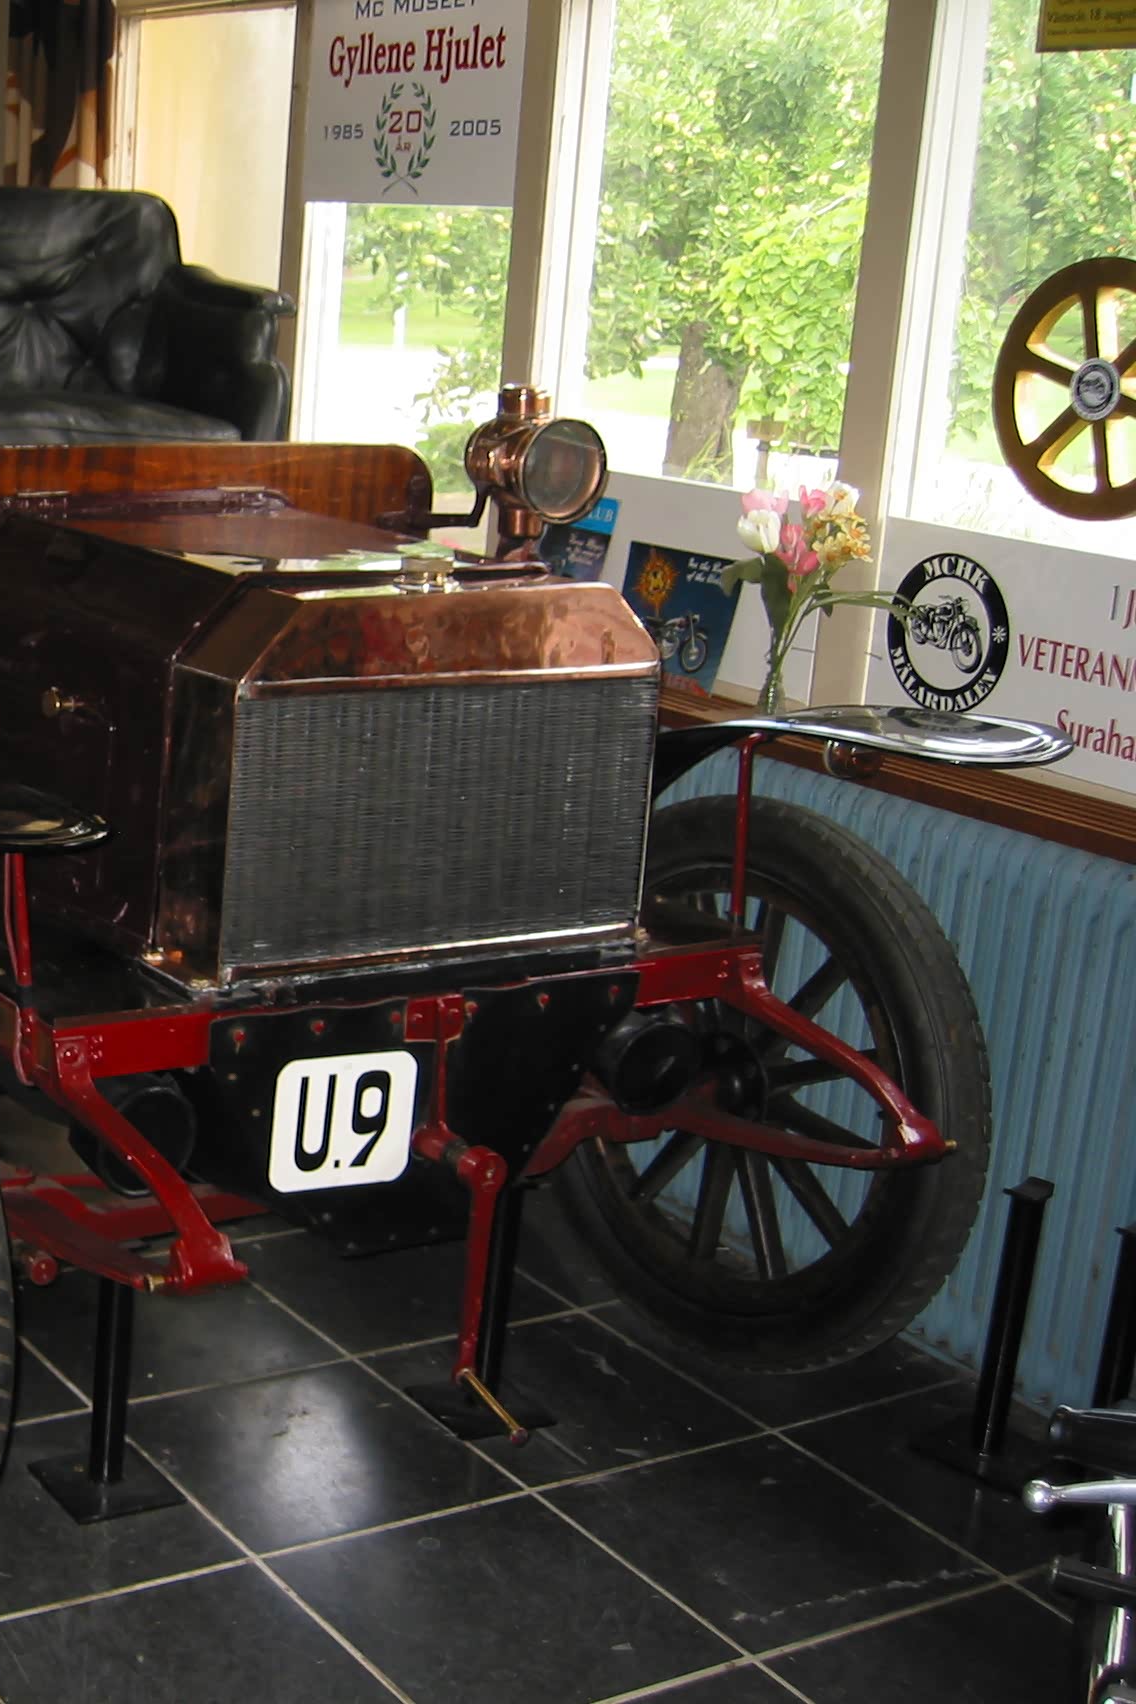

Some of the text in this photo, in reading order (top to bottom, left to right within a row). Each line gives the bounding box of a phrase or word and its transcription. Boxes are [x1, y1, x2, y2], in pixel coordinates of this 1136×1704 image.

[355, 0, 384, 20] MC
[329, 24, 507, 88] Gyllene Hjulet
[323, 123, 364, 141] 1985
[388, 110, 422, 134] 20
[449, 119, 502, 137] 2005
[922, 555, 990, 595] MCHK
[1122, 588, 1136, 630] J
[890, 646, 998, 712] MÄLARDALEN
[1056, 708, 1136, 763] Suraha
[293, 1069, 392, 1173] U.9
